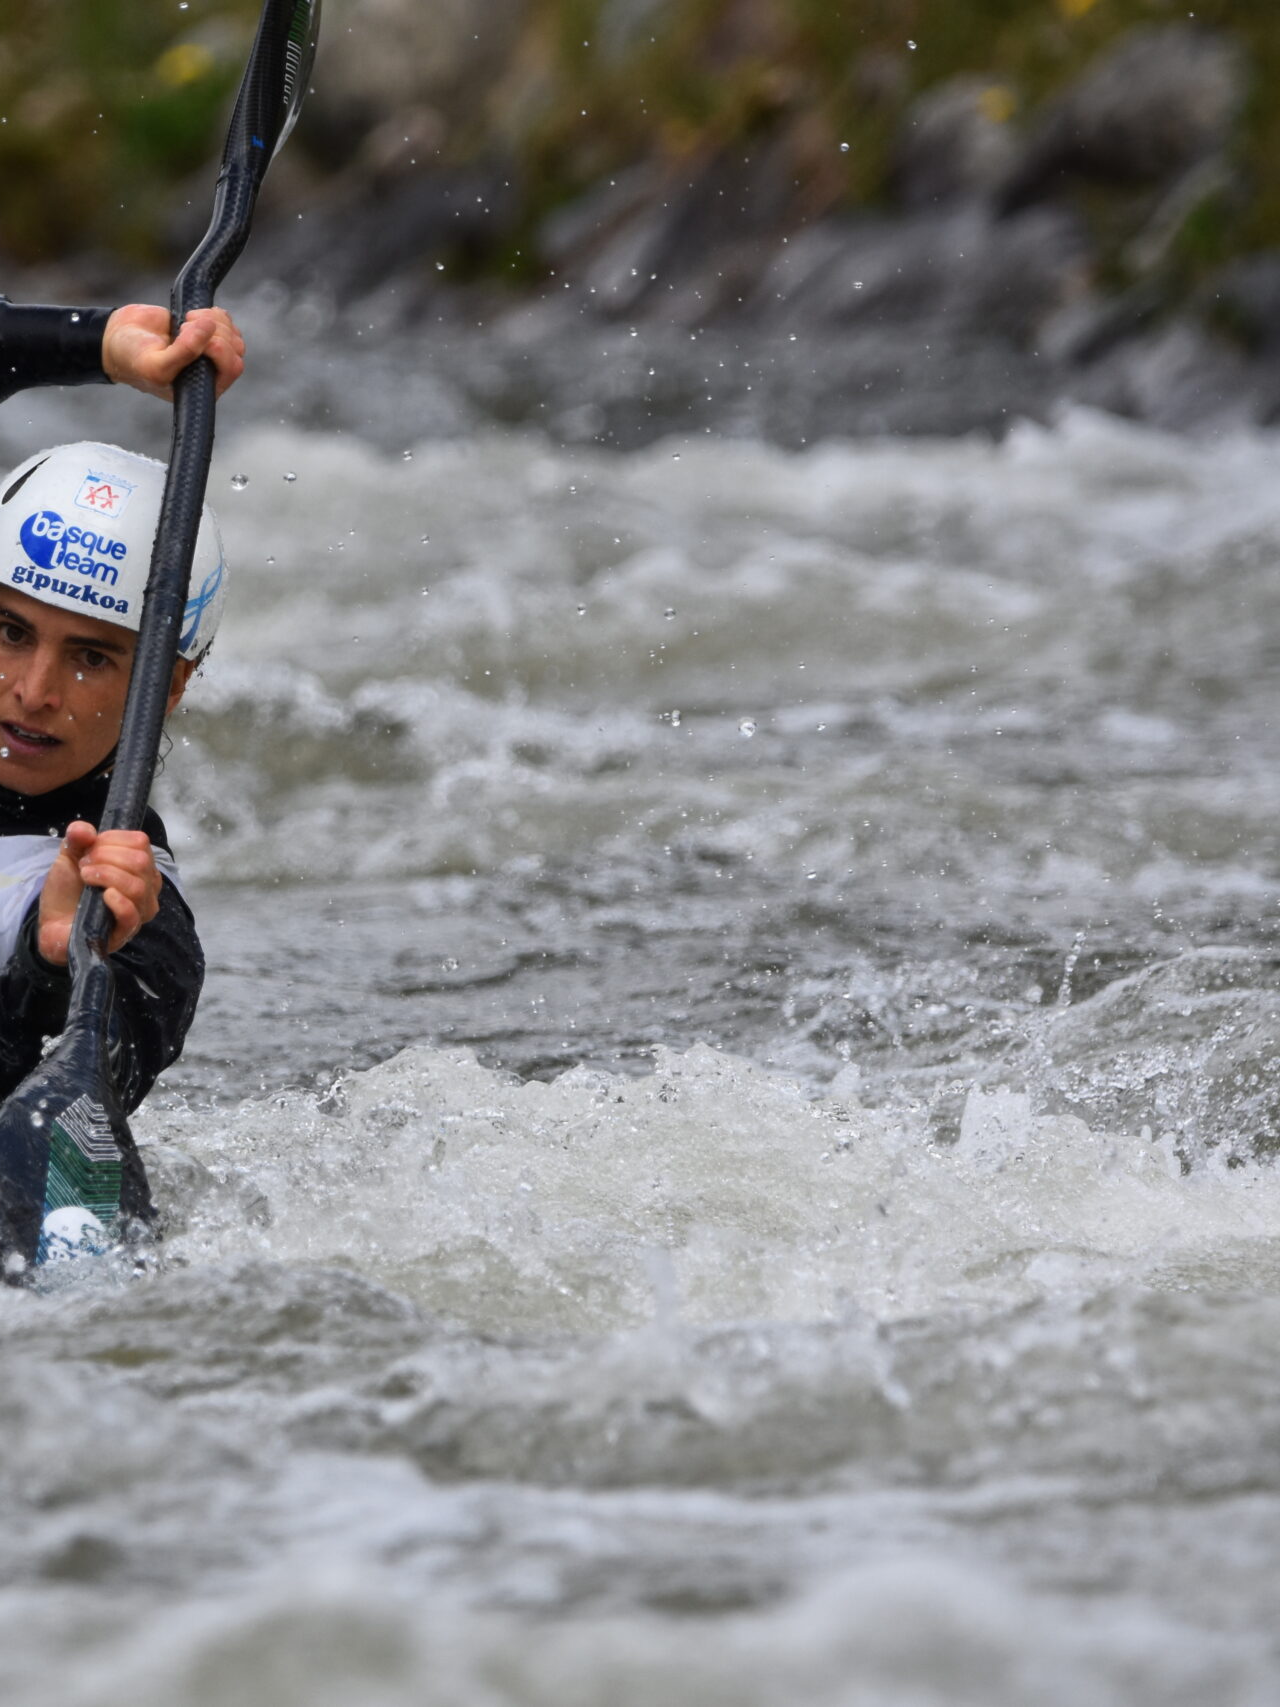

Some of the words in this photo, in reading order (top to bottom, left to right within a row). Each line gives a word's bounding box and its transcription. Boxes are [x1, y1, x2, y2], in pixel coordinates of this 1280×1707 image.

[31, 510, 128, 560] basque
[49, 539, 120, 586] team
[11, 564, 130, 615] gipuzkoa
